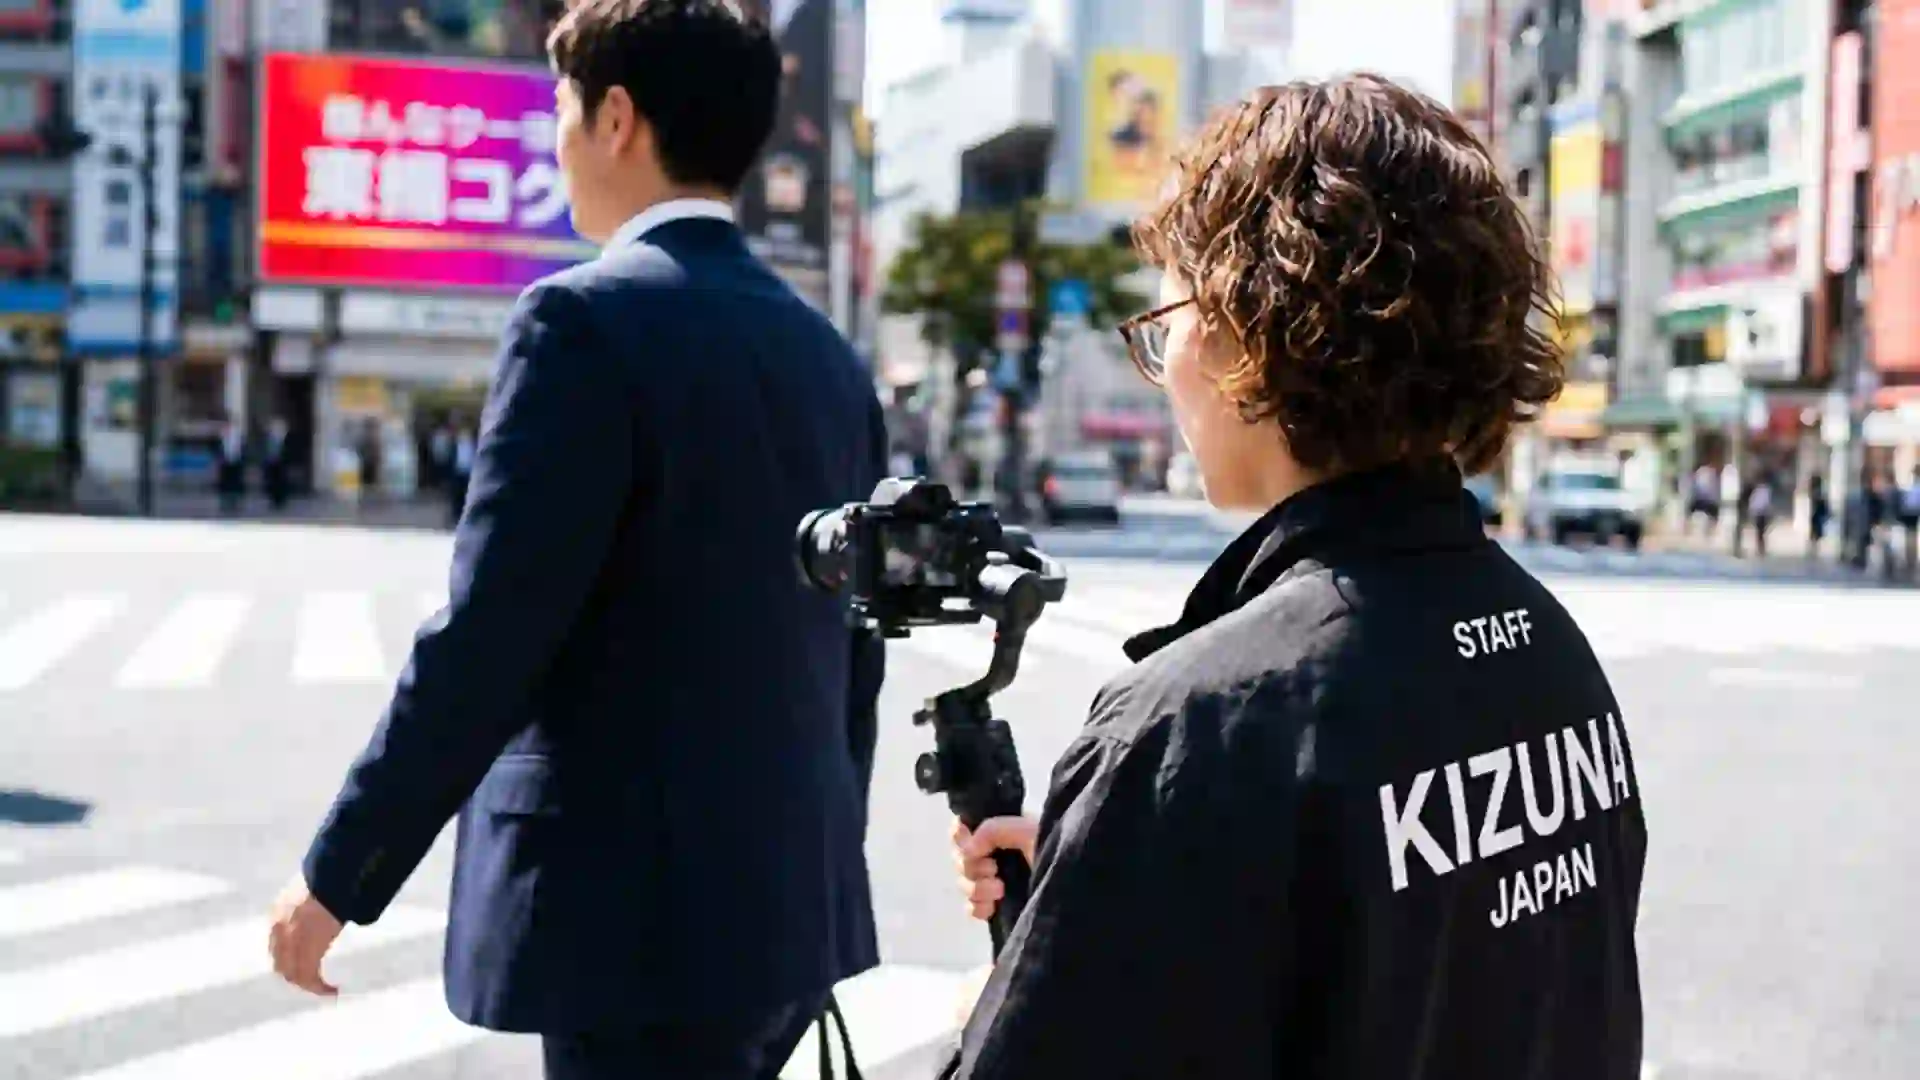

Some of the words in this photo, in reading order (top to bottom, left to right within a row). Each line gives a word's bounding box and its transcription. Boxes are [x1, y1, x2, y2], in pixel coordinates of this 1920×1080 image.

[1453, 608, 1532, 658] STAFF
[1379, 712, 1630, 892] KIZUNA
[1490, 842, 1597, 928] JAPAN
